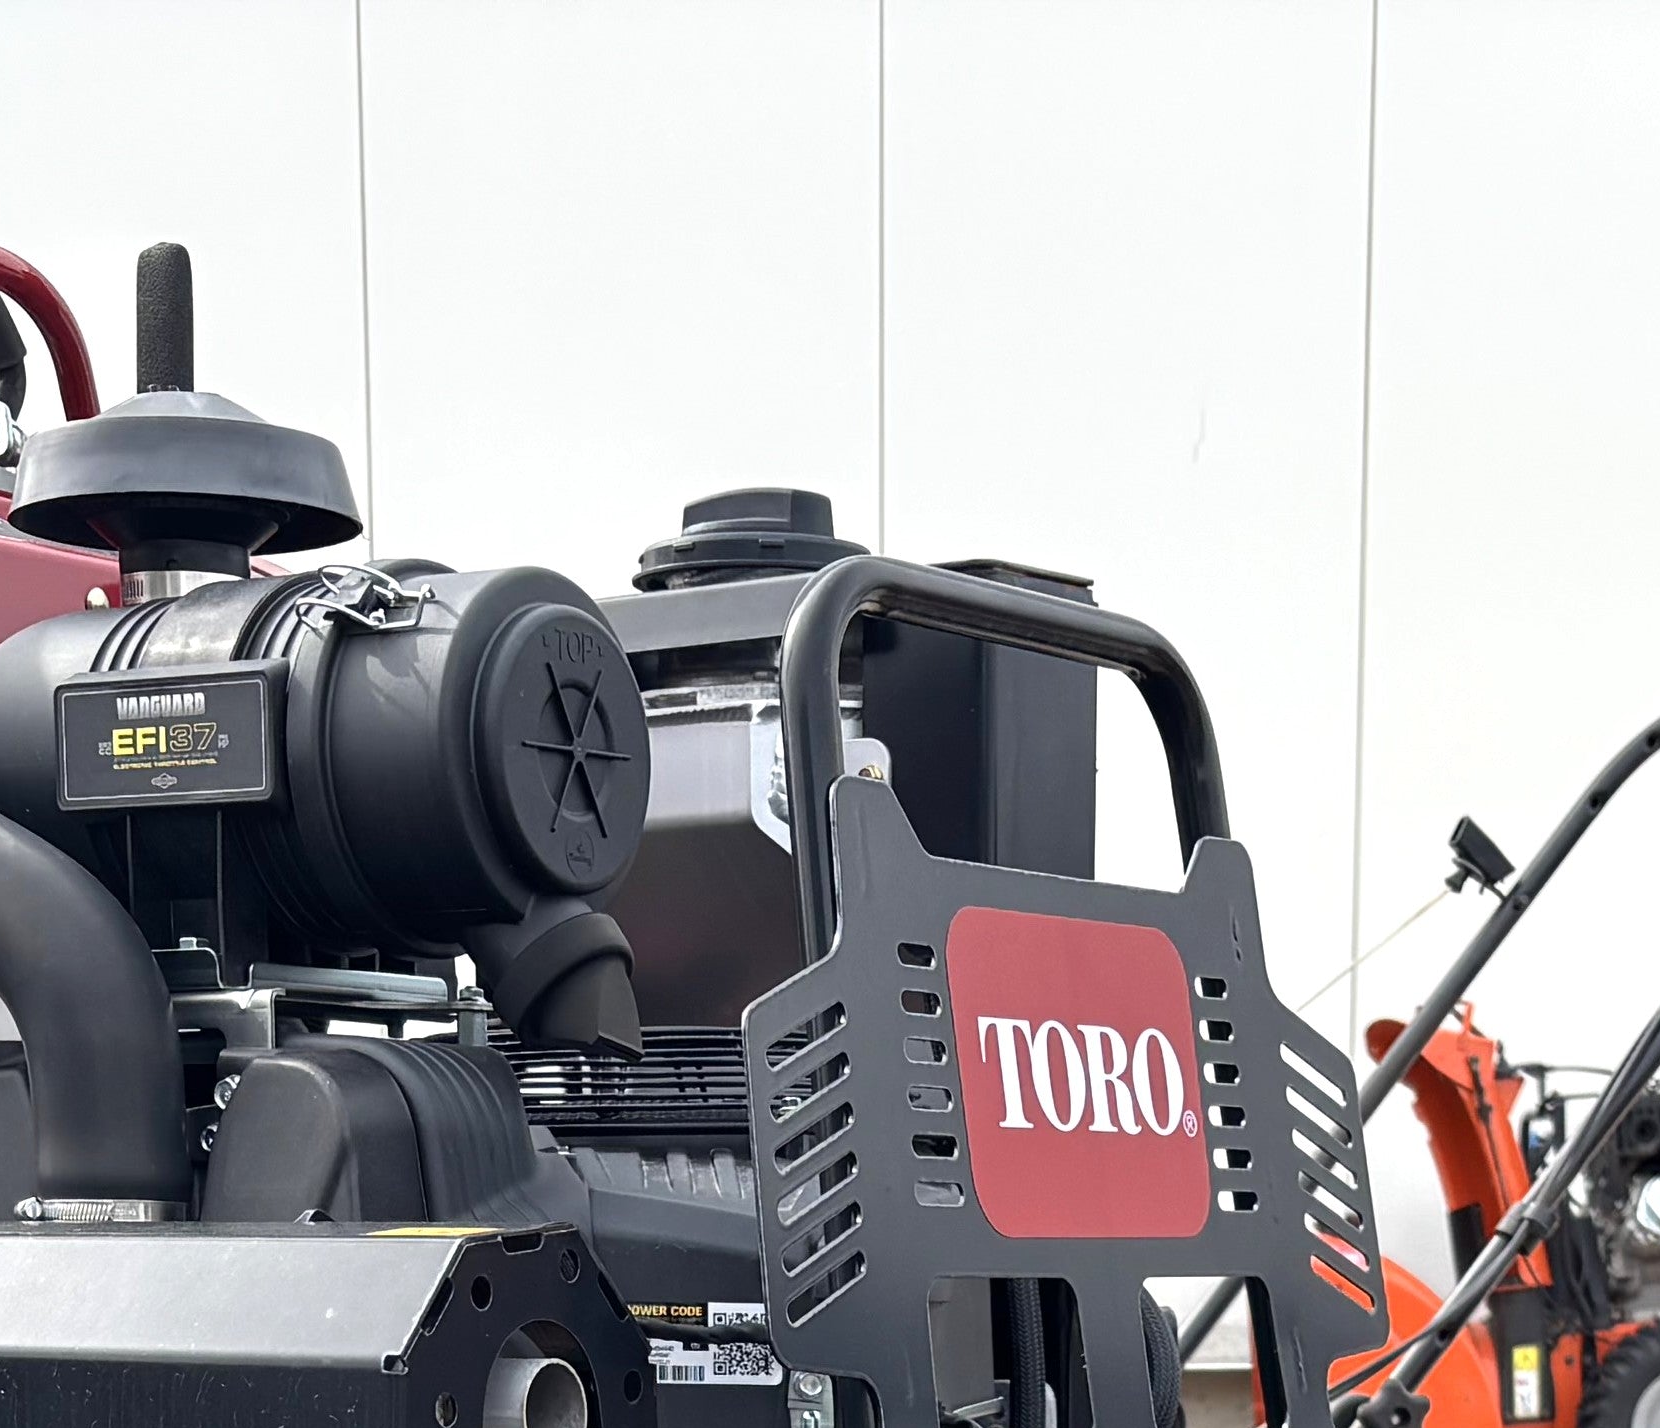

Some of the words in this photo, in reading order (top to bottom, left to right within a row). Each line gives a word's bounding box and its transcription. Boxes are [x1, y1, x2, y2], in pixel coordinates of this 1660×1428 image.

[554, 626, 593, 664] TOP
[116, 692, 206, 720] VANGUARD
[670, 1306, 703, 1316] CODE
